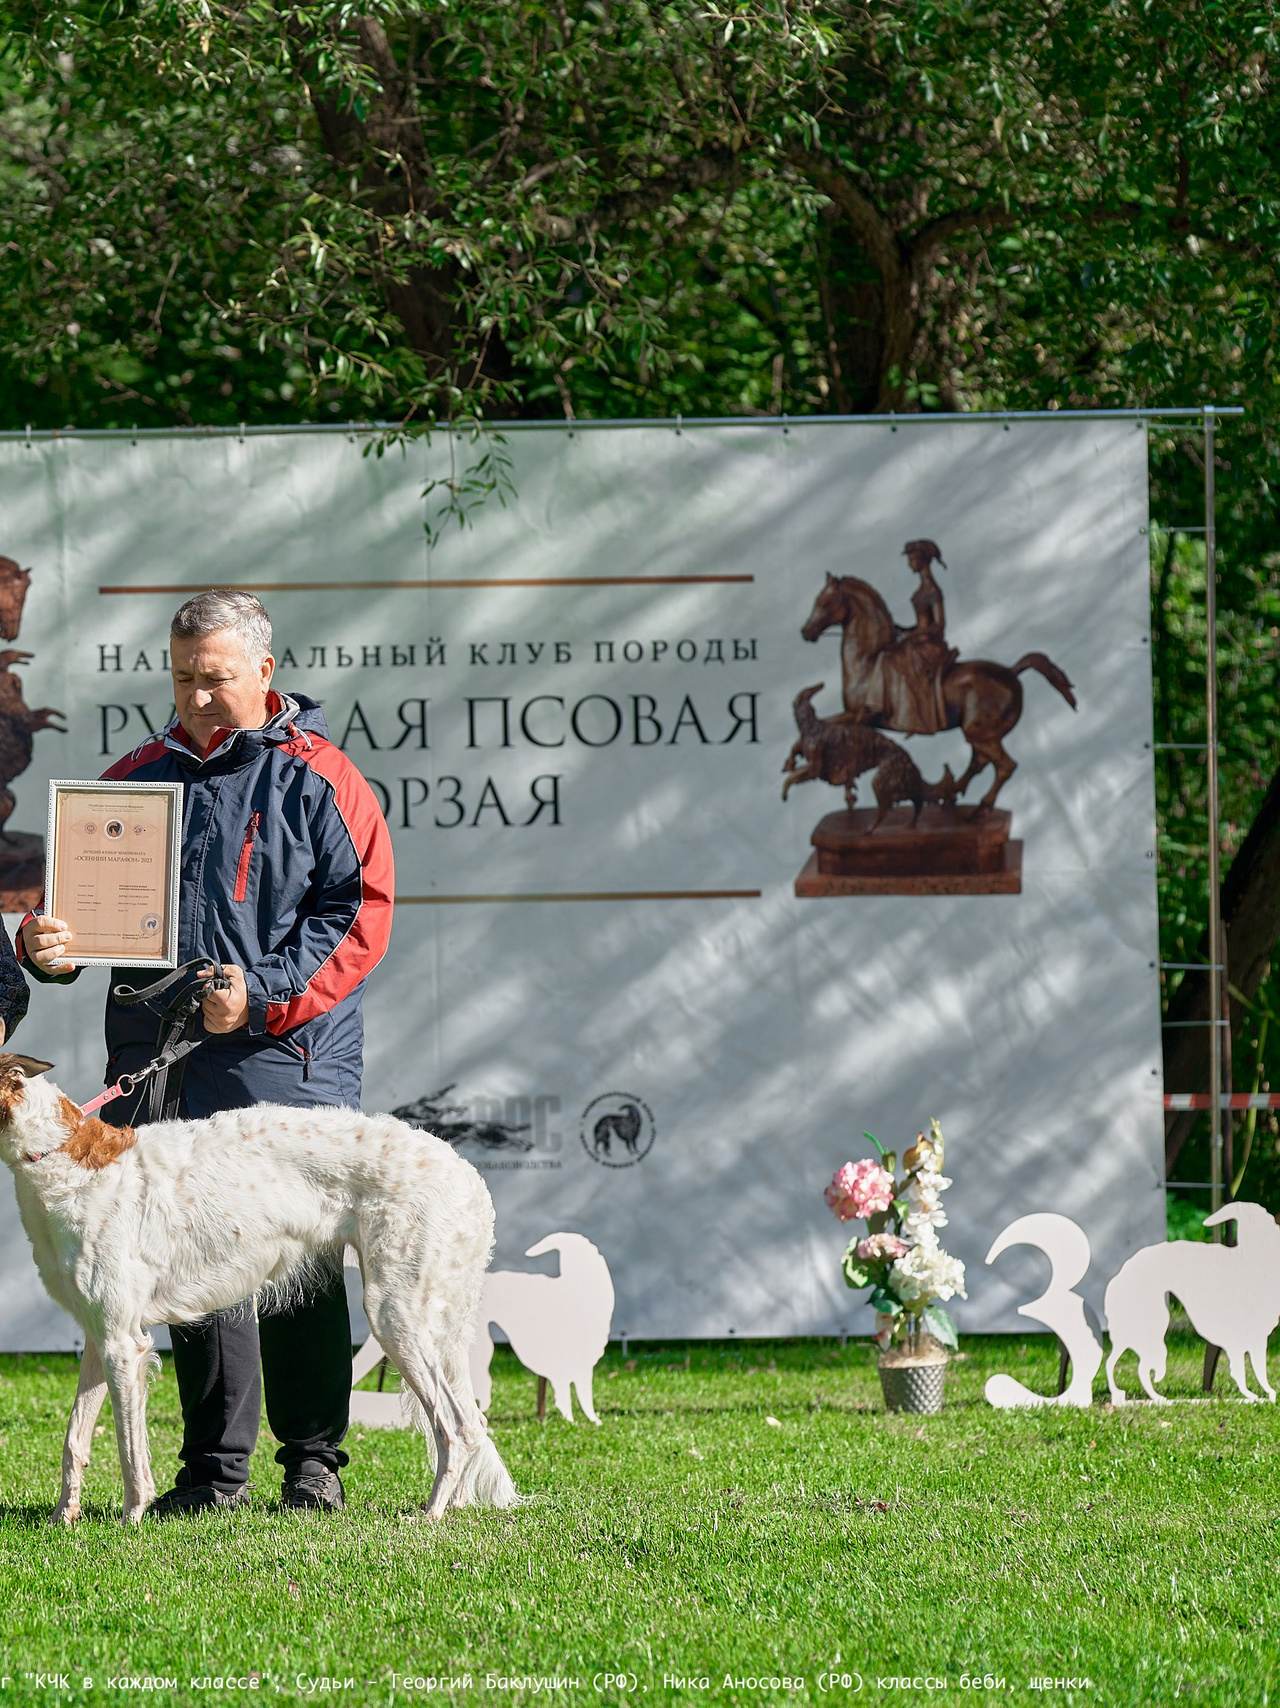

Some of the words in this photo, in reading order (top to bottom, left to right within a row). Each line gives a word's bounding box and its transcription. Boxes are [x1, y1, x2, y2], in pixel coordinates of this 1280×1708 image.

[469, 642, 573, 666] КЛУБ
[594, 638, 759, 665] ПОРОДЫ
[97, 698, 431, 755] РУАЯ
[466, 691, 761, 749] ПСОВАЯ
